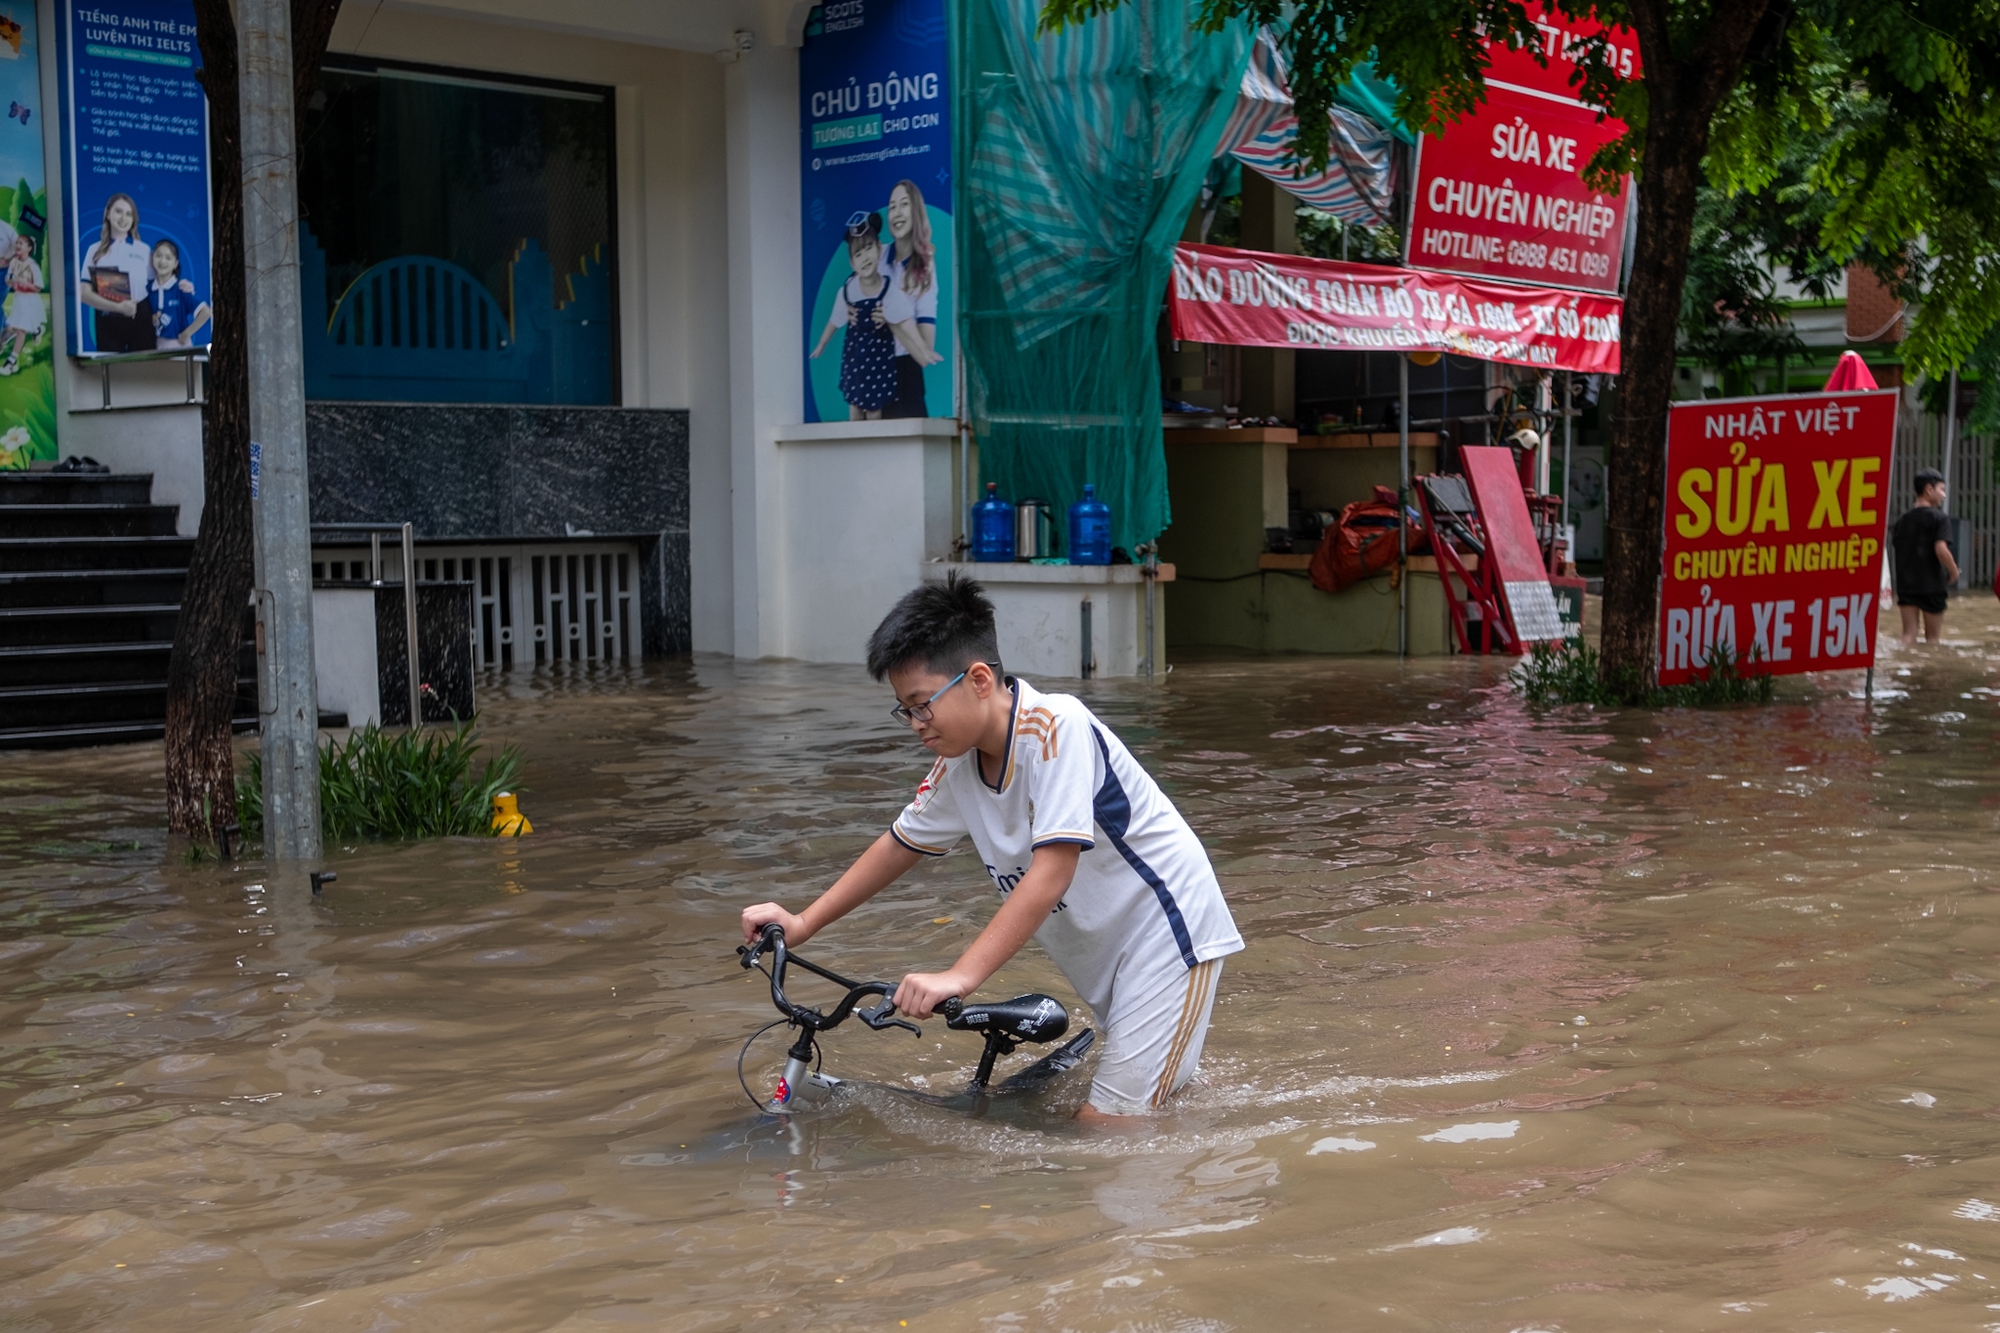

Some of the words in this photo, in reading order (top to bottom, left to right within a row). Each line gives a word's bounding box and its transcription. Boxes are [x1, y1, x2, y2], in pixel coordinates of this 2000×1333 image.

[78, 9, 119, 26] TIẾNG
[122, 16, 150, 30] ANH
[153, 19, 176, 34] TRẺ
[179, 24, 197, 36] EM
[825, 0, 864, 20] SCOTS
[825, 16, 864, 33] ENGLISH
[86, 29, 127, 45] LUYỆN
[130, 34, 153, 47] THI
[156, 38, 191, 53] IELTS
[812, 76, 860, 117] CHỦ
[866, 71, 938, 111] ĐỘNG
[814, 125, 855, 143] TƯƠNG
[857, 122, 879, 138] LAI
[883, 117, 909, 134] CHO
[912, 113, 939, 129] CON
[1491, 116, 1541, 166] SỬA
[1545, 134, 1577, 172] XE
[1428, 177, 1530, 226] CHUYÊN
[1532, 194, 1615, 246] NGHIỆP
[1422, 227, 1504, 264] HOTLINE:
[1507, 240, 1548, 269] 0988
[1549, 246, 1577, 274] 451
[1581, 251, 1610, 278] 098
[1174, 250, 1223, 304] BẢO
[1228, 262, 1312, 310] DƯỠNG
[1314, 273, 1379, 317] TOÀN
[1380, 277, 1414, 327] BỘ
[1415, 288, 1447, 322] XE
[1446, 293, 1476, 328] GA
[1475, 302, 1522, 333] 180K
[1530, 305, 1556, 336] XE
[1557, 296, 1580, 339] SỐ
[1287, 321, 1340, 349] ĐƯỢC
[1342, 322, 1421, 346] KHUYẾN
[1469, 334, 1498, 360] HỘP
[1500, 336, 1528, 362] DẦU
[1530, 342, 1557, 364] MÁY
[1705, 405, 1787, 440] NHẬT
[1795, 402, 1860, 436] VIỆT
[1675, 441, 1790, 539] SỬA
[1807, 457, 1881, 530] XE
[1674, 541, 1777, 581] CHUYÊN
[1785, 533, 1878, 574] NGHIỆP
[1665, 584, 1737, 670] RỬA
[1747, 600, 1795, 664] XE
[1807, 593, 1873, 659] 15K
